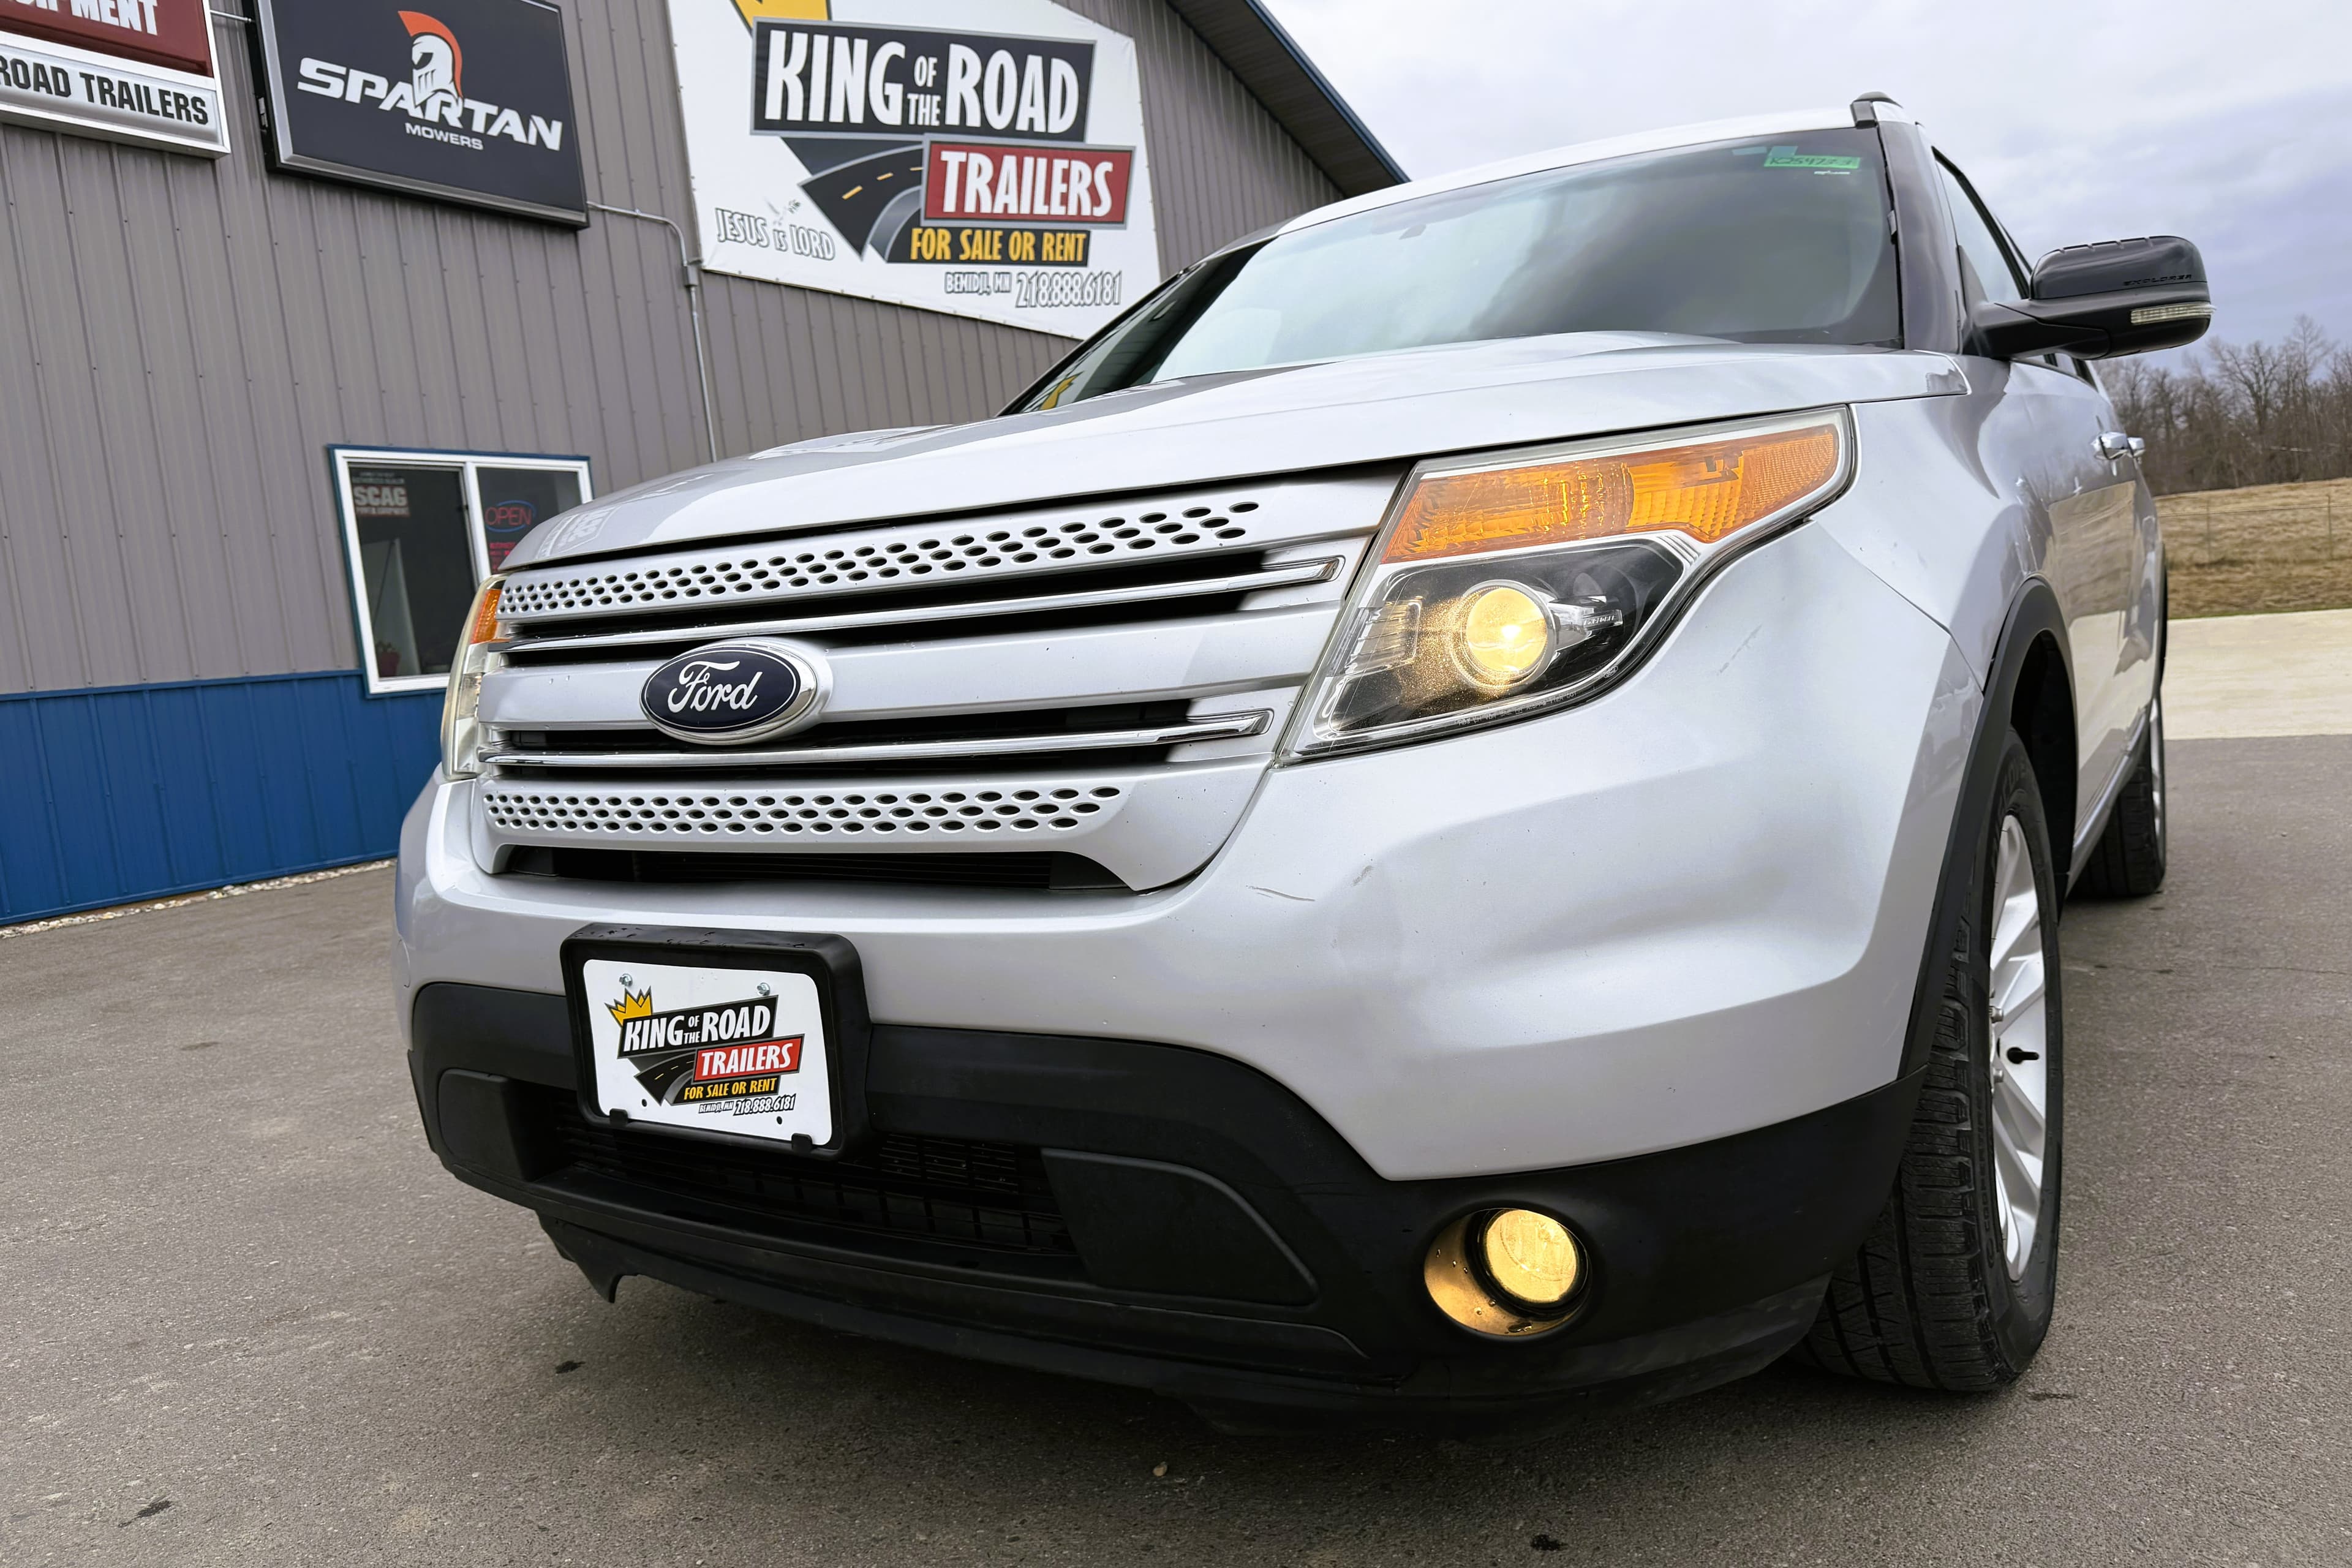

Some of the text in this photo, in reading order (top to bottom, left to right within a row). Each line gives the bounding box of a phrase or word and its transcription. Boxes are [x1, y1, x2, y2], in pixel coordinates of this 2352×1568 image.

[80, 72, 208, 125] TRAILERS
[765, 29, 1079, 134] KING OF THE ROAD
[298, 57, 562, 151] SPARTAN
[404, 122, 484, 151] MOWERS
[940, 150, 1114, 217] TRAILERS
[715, 207, 771, 248] JESUS
[788, 224, 837, 261] LORD
[910, 227, 1087, 262] FOR SALE OR RENT
[992, 271, 1012, 293] MN
[1014, 270, 1123, 308] 218.888.6181
[353, 486, 408, 507] SCAG
[484, 507, 532, 526] OPEN
[667, 660, 763, 713] Ford
[623, 1005, 771, 1052] KING OF THE ROAD
[701, 1042, 794, 1077] TRAILERS
[684, 1077, 778, 1101] FOR SALE OR RENT
[733, 1093, 797, 1117] 218.888.6181
